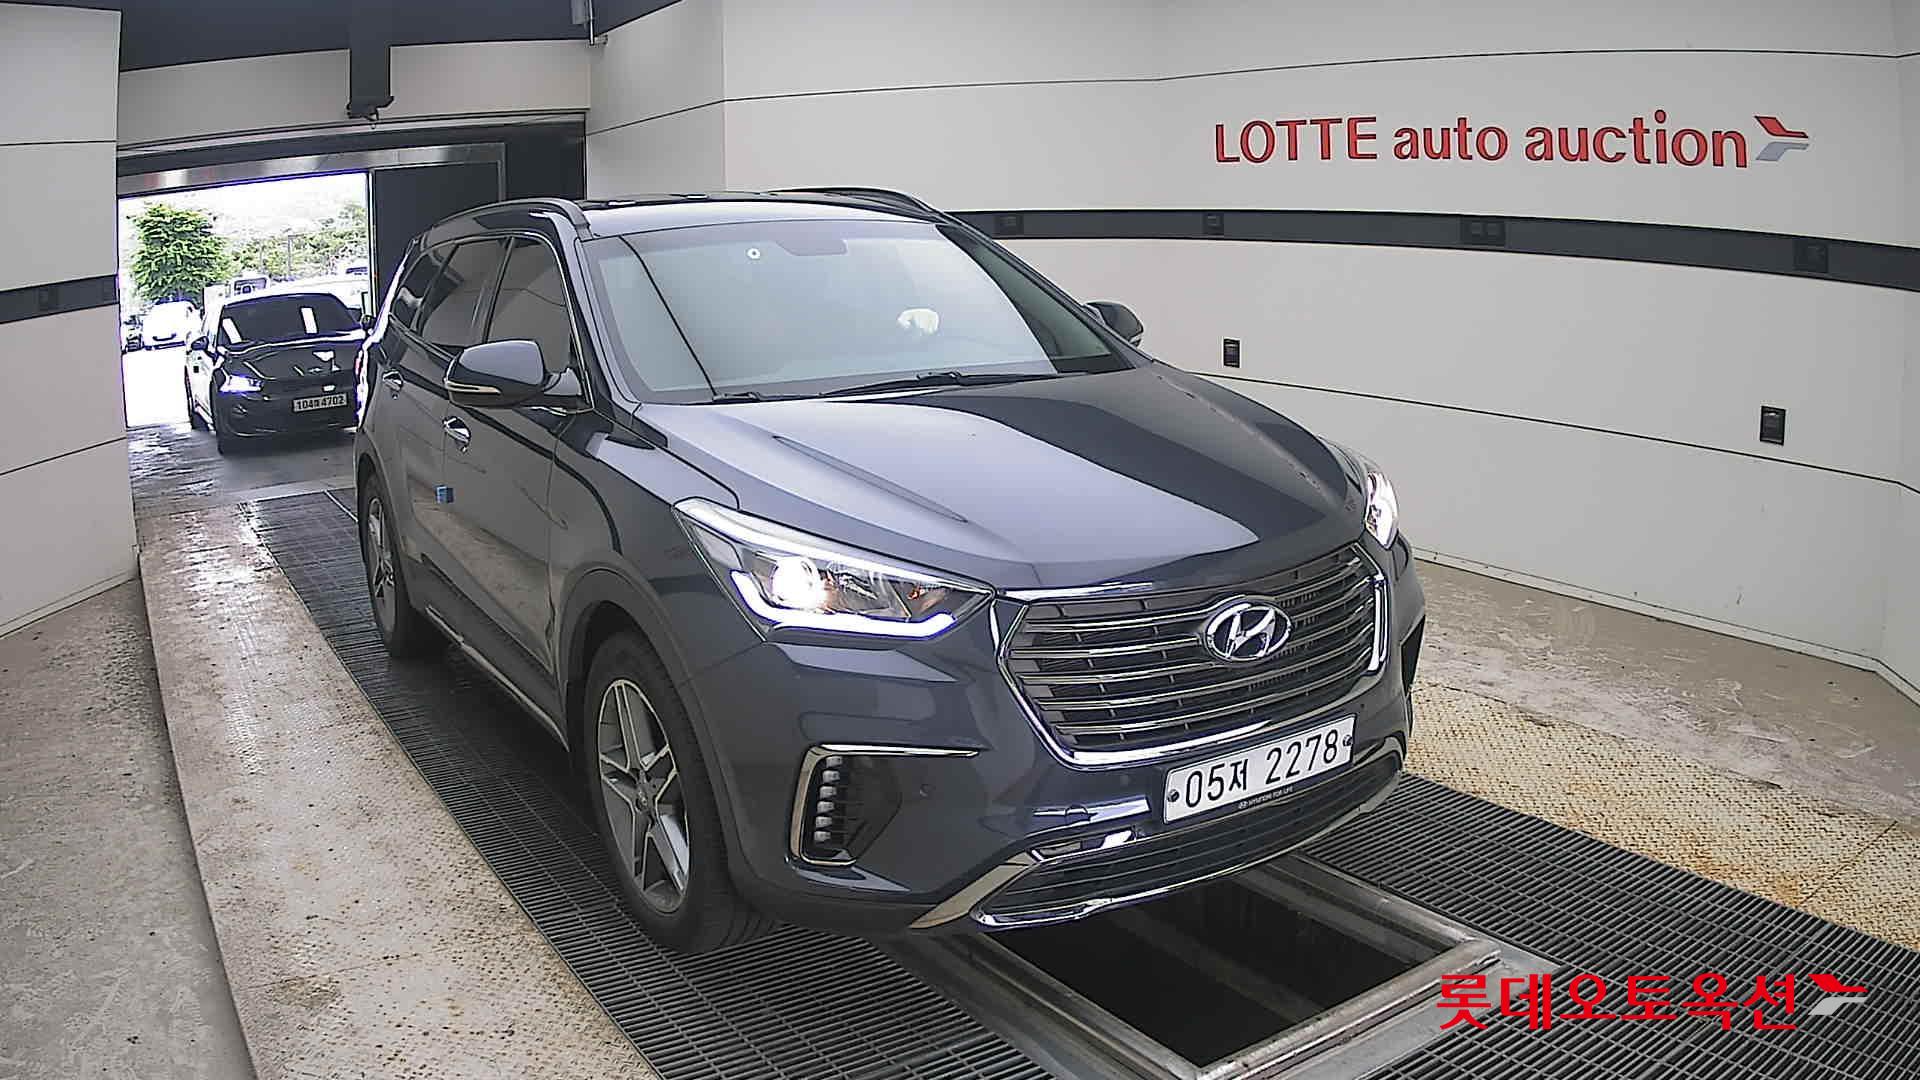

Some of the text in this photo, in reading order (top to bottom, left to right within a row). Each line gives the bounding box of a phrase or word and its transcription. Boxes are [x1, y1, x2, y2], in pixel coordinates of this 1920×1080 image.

[1215, 109, 1748, 168] LOTTE auto auction
[1185, 729, 1339, 808] 05저 2278
